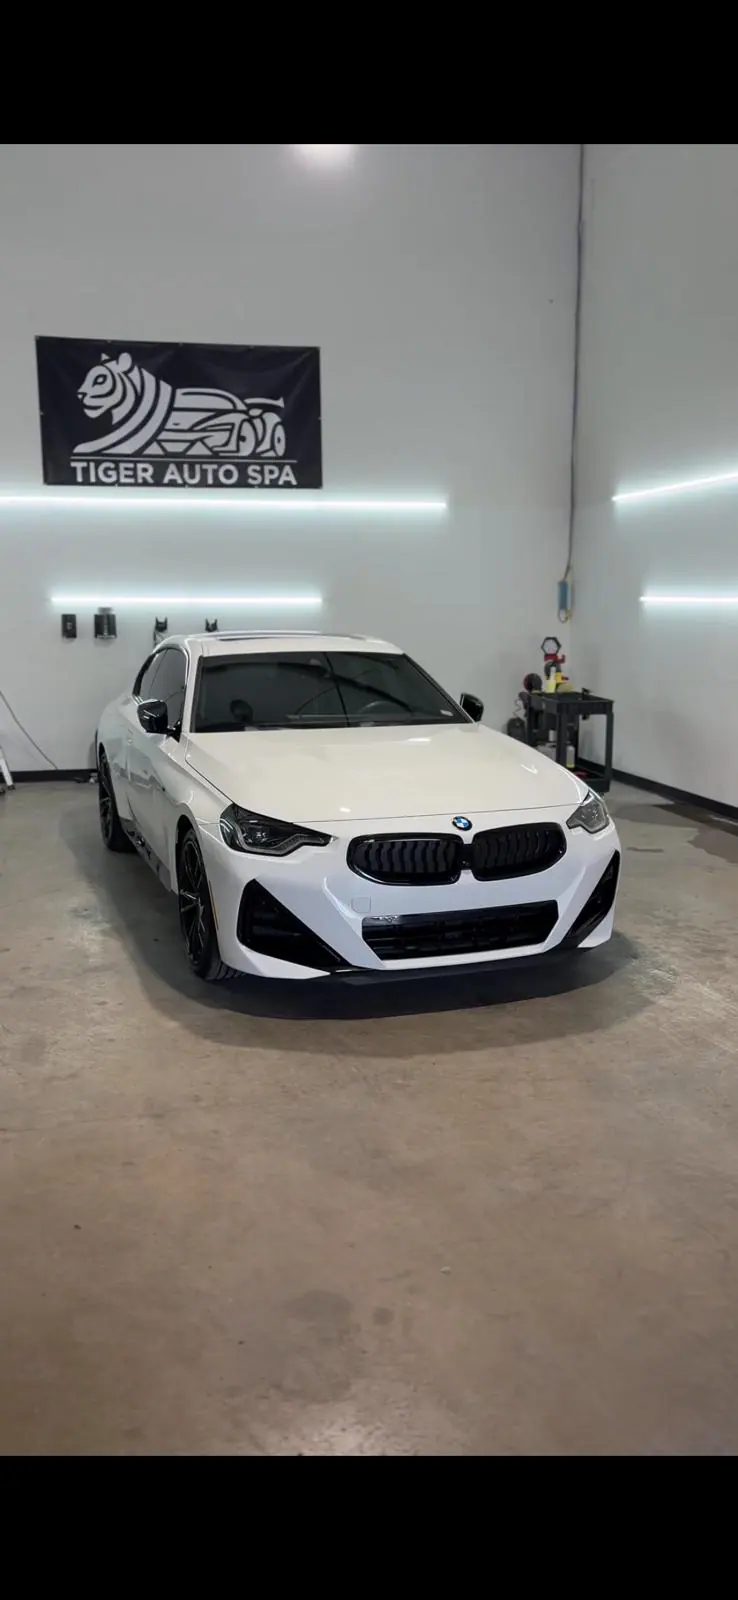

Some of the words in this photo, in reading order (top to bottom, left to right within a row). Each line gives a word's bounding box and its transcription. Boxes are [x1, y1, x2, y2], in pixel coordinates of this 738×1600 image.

[70, 461, 154, 484] TIGER
[162, 463, 239, 485] AUTO
[247, 465, 297, 486] SPA
